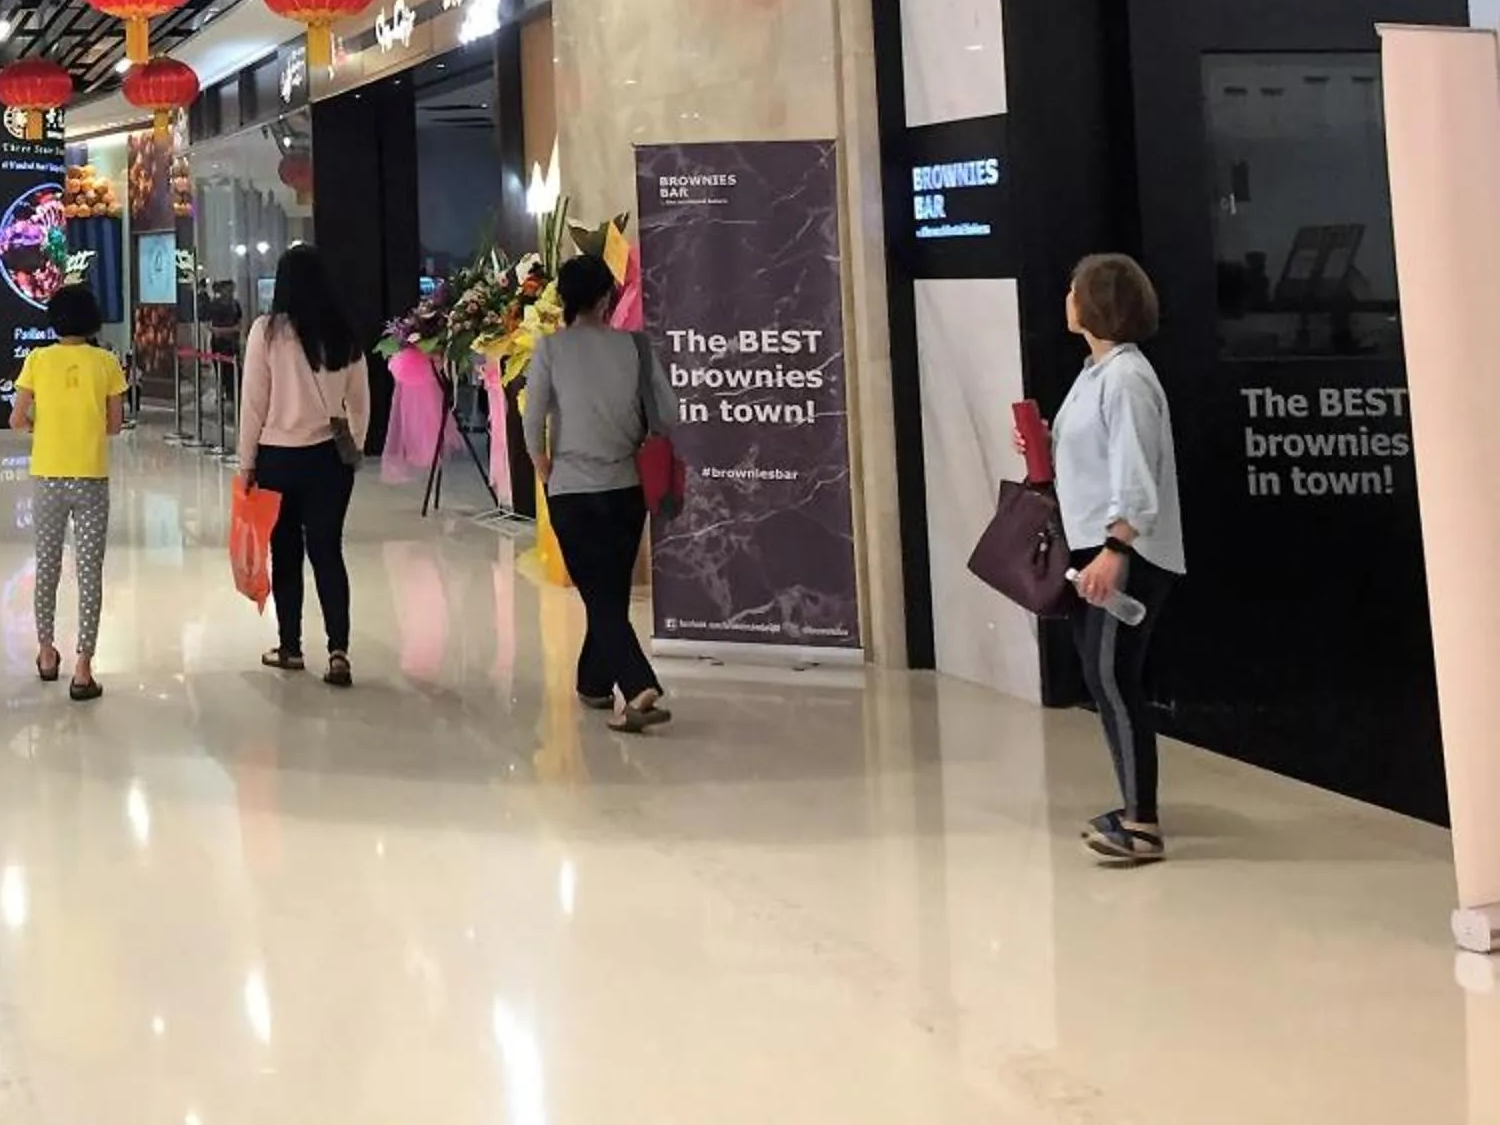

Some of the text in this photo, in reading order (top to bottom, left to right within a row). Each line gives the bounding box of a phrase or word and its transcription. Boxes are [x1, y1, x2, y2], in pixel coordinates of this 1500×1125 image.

[659, 174, 737, 186] BROWNIES
[912, 158, 999, 191] BROWNIES
[659, 187, 689, 198] BAR
[913, 194, 947, 220] BAR
[666, 329, 823, 353] The BEST
[670, 363, 823, 388] brownies
[679, 398, 816, 424] in town!
[1240, 386, 1407, 418] The BEST
[1245, 425, 1410, 458] brownies
[701, 467, 799, 480] #browniesbar
[1247, 464, 1394, 496] in town!
